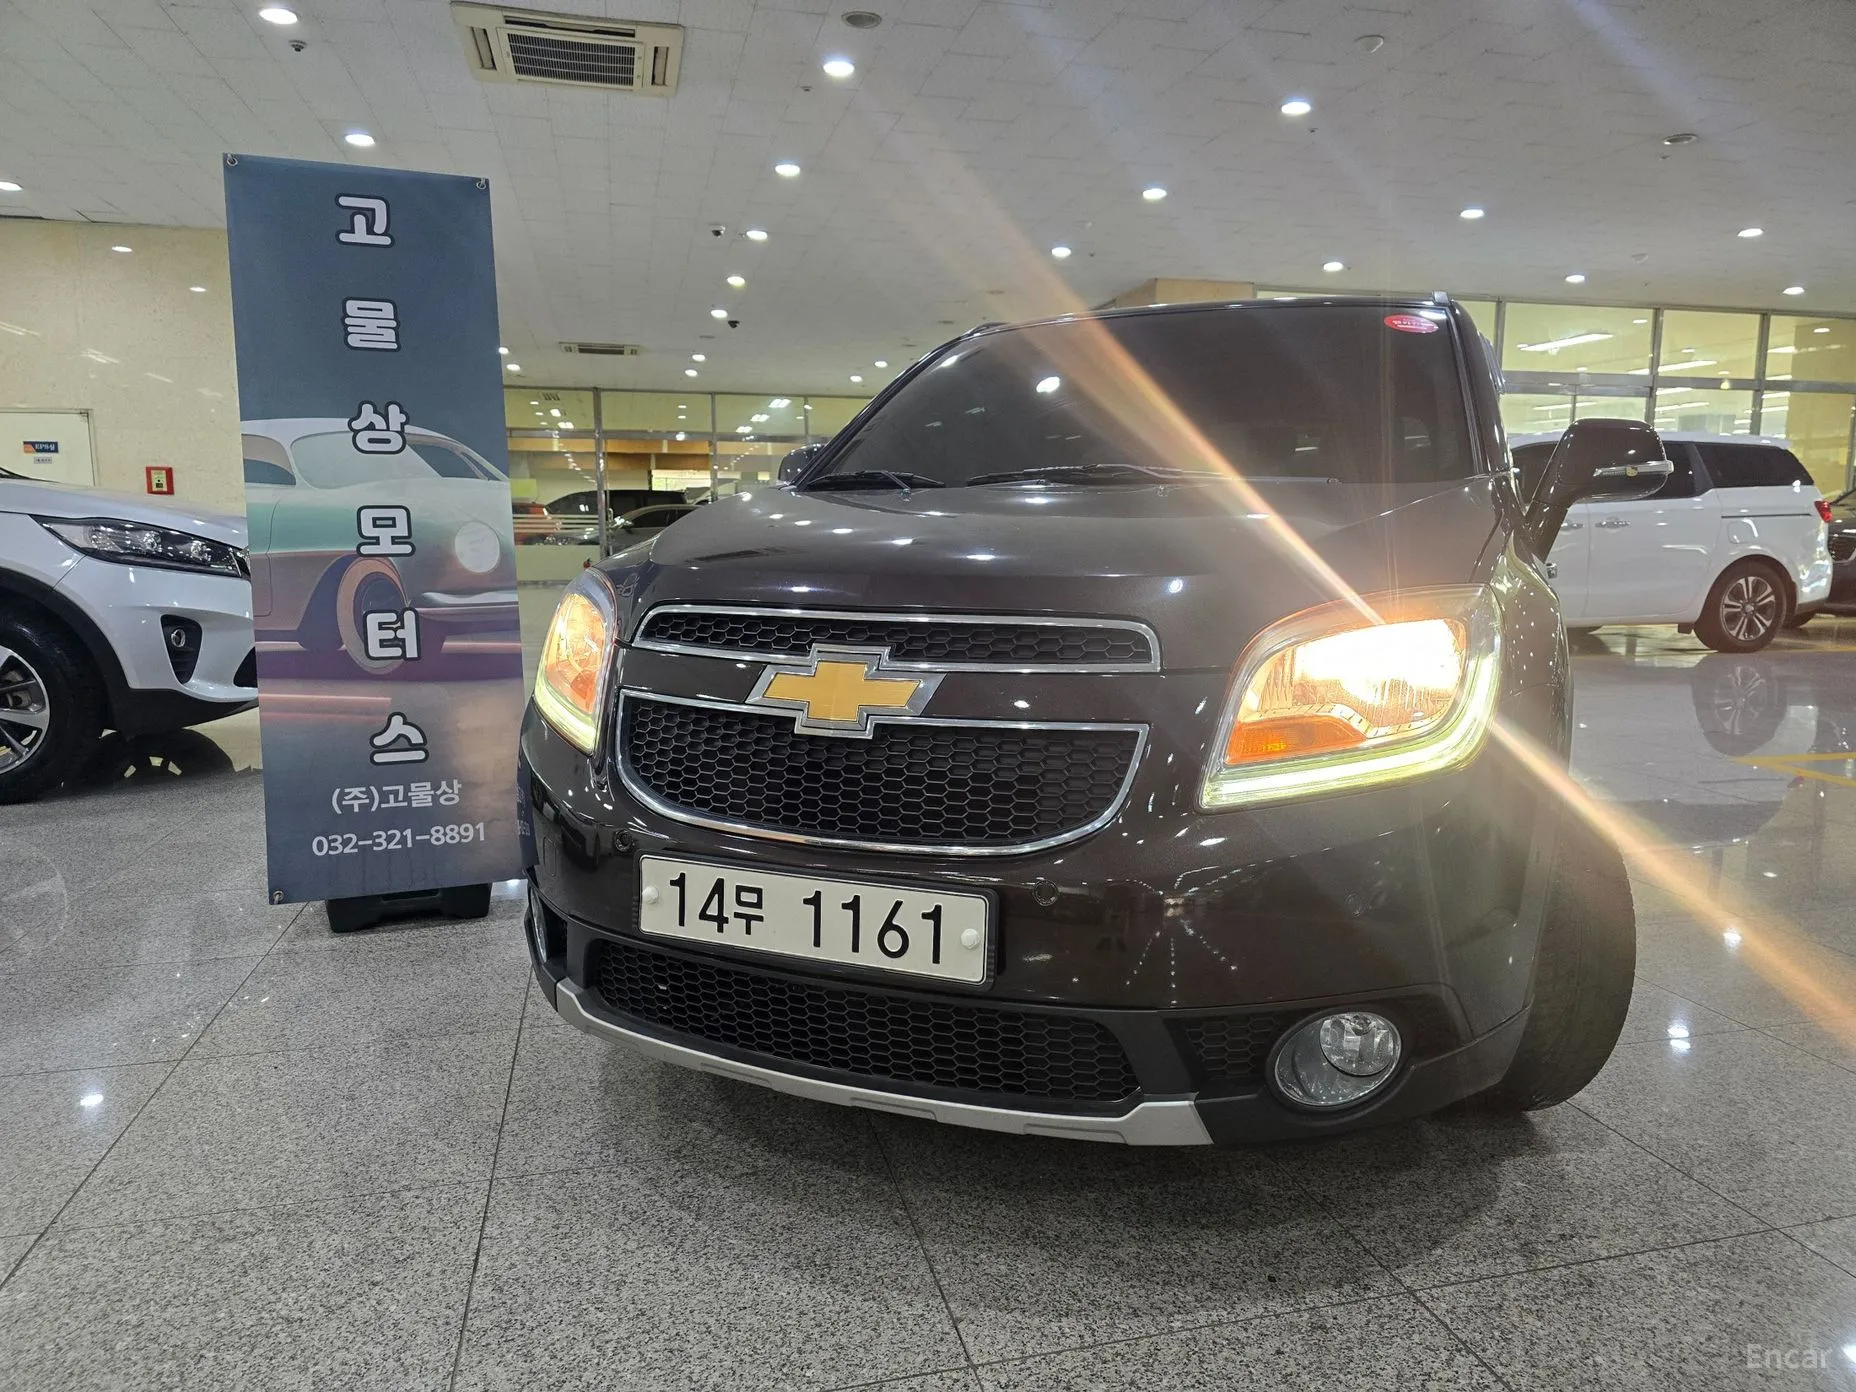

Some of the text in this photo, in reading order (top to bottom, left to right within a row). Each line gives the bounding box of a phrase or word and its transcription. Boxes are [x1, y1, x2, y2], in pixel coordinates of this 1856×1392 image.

[331, 779, 462, 814] (주)고물상
[312, 822, 486, 856] 032-321-8891
[669, 872, 943, 965] 14무 1161
